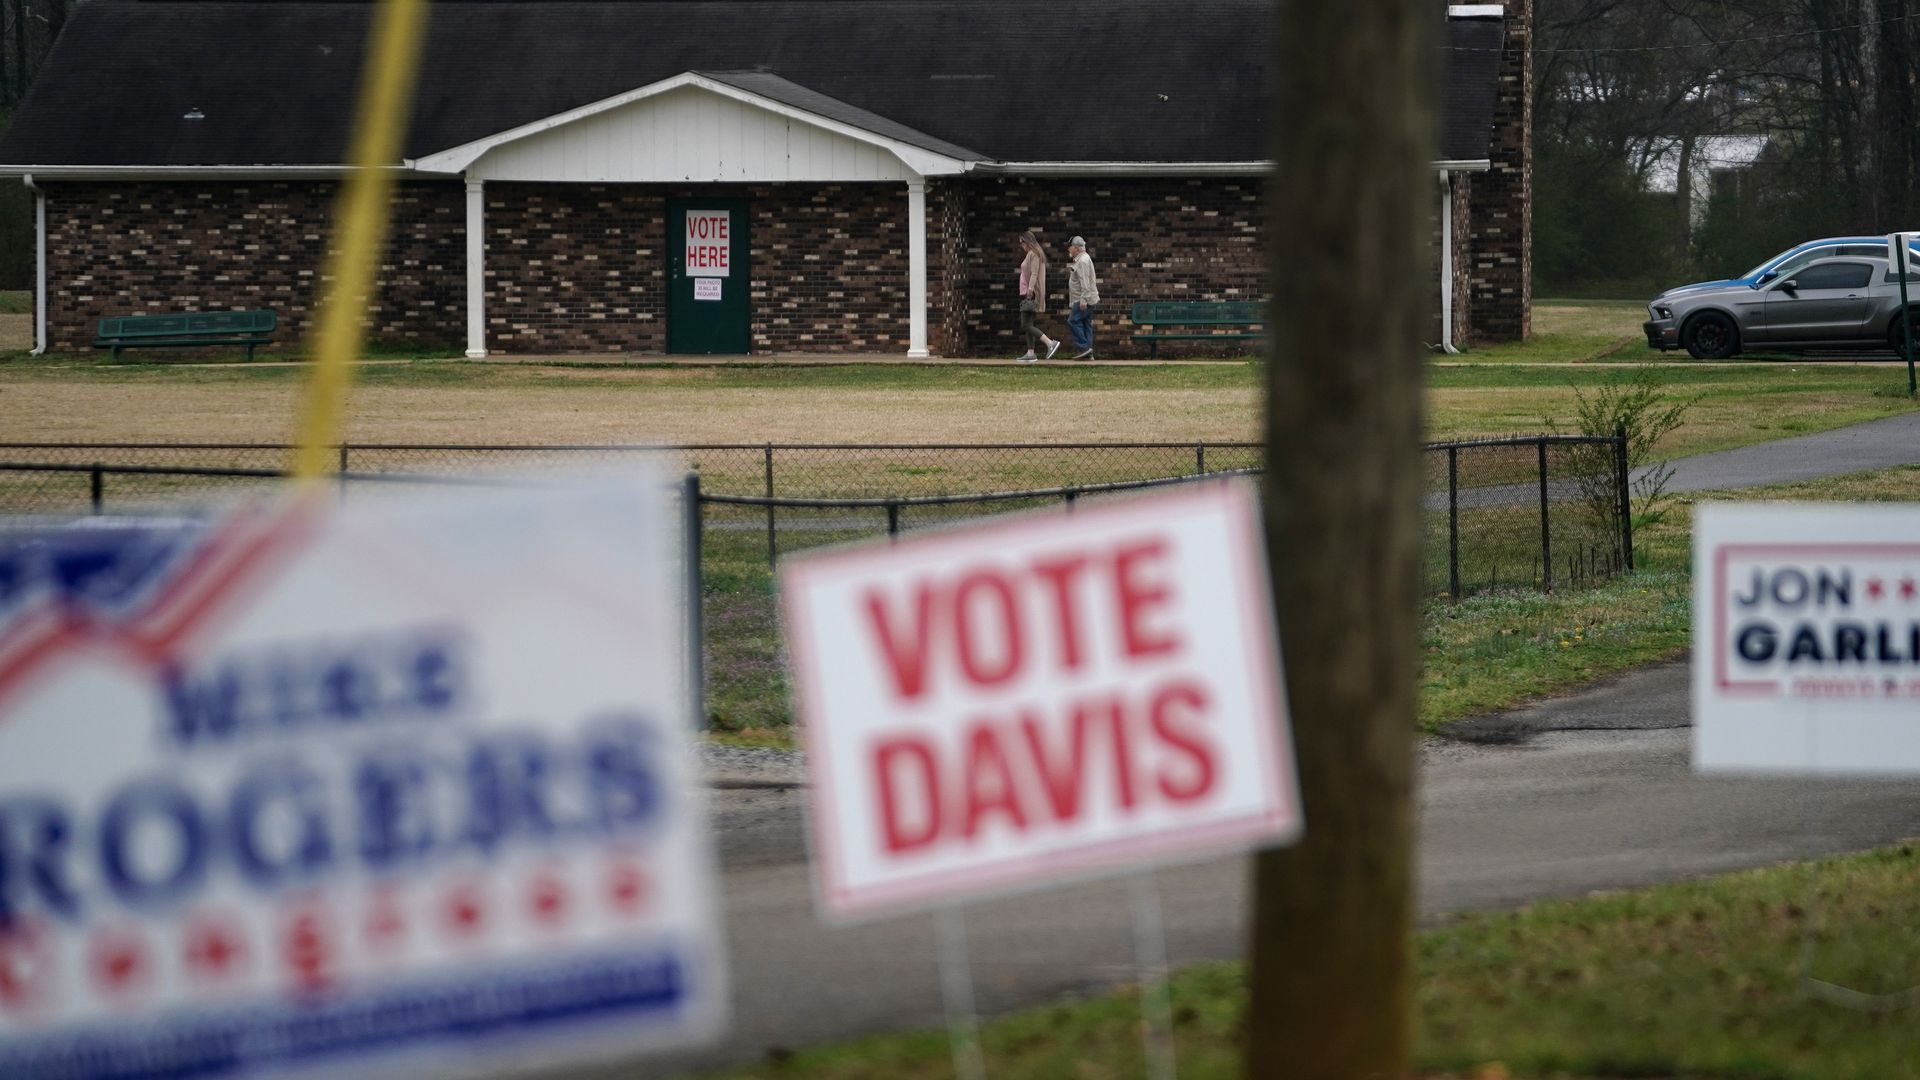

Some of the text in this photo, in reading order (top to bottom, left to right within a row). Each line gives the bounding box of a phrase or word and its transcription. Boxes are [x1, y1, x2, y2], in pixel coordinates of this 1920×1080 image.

[688, 216, 728, 239] VOTE
[688, 245, 728, 268] HERE
[864, 536, 1183, 700] VOTE
[1734, 566, 1854, 611] JON
[0, 712, 664, 922] ROGERS
[870, 682, 1221, 857] DAVIS
